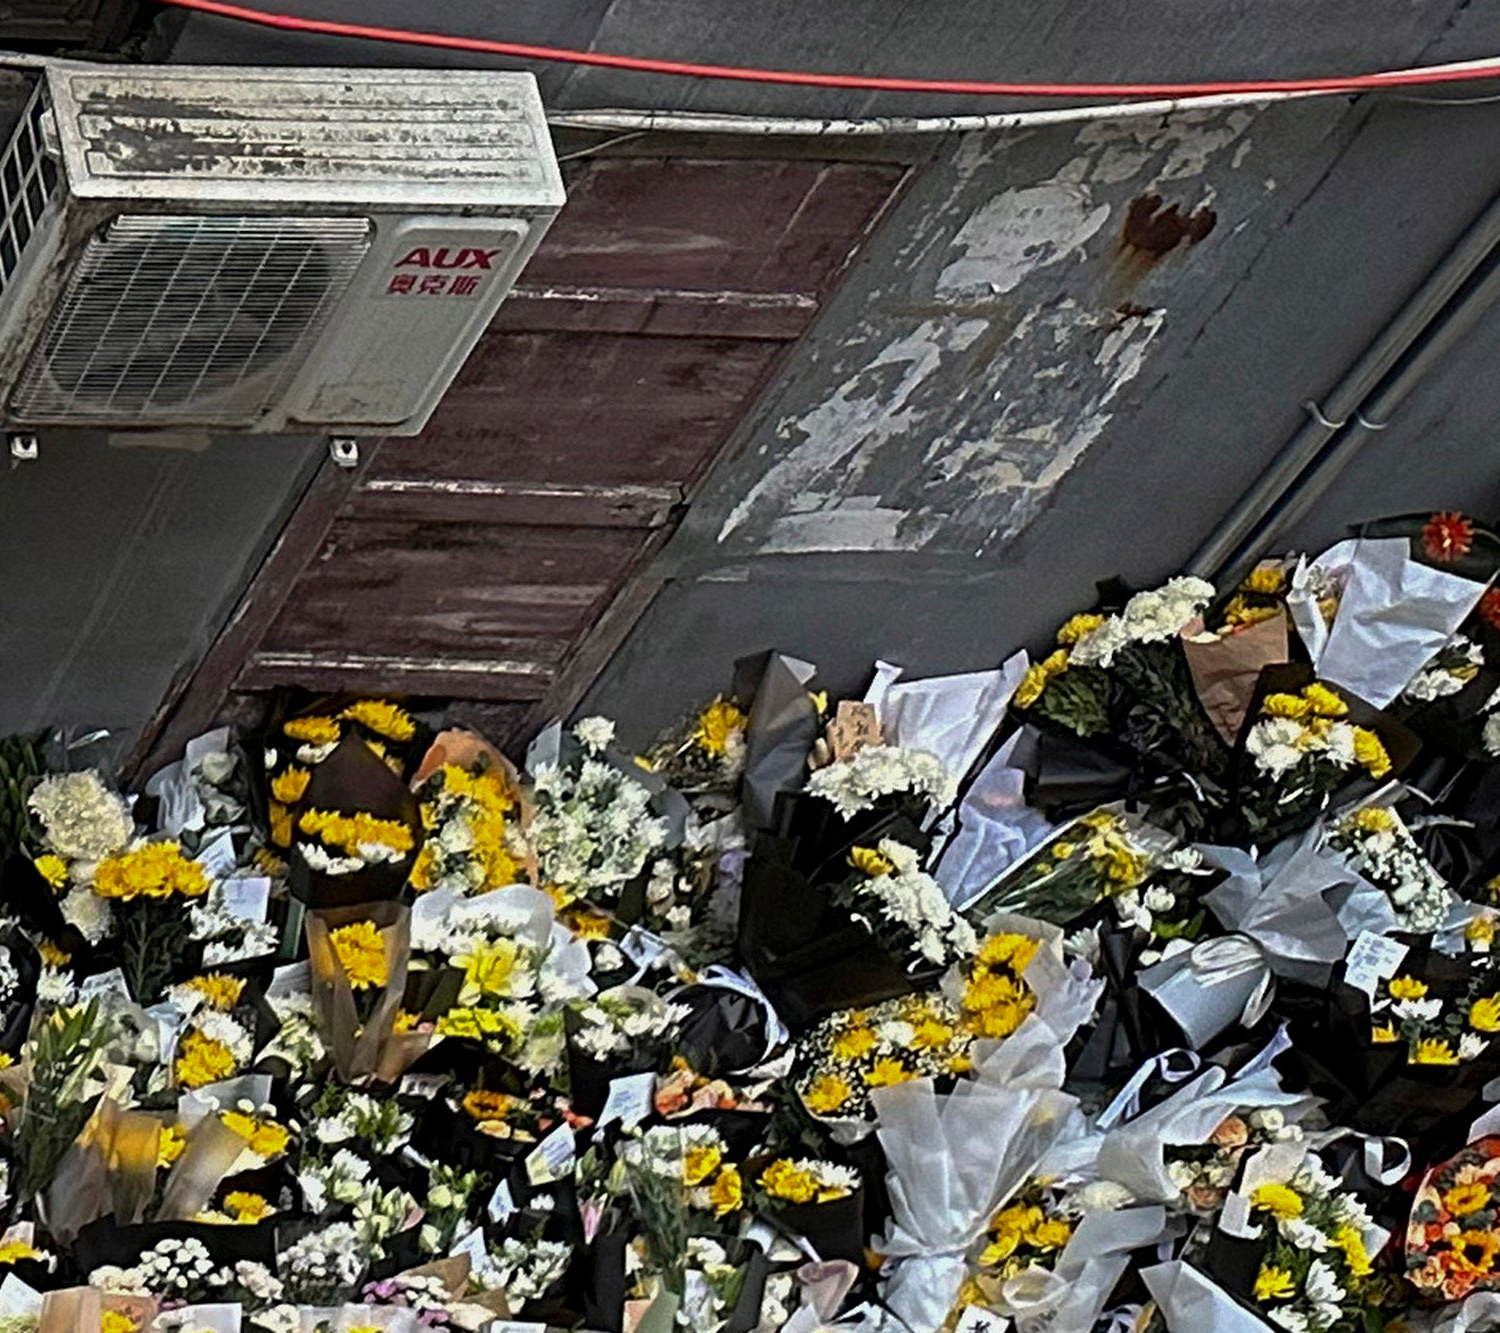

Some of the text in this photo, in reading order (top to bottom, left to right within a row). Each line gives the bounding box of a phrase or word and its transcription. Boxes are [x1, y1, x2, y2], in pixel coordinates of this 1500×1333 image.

[393, 247, 503, 270] AUX
[386, 273, 482, 296] 奥克斯
